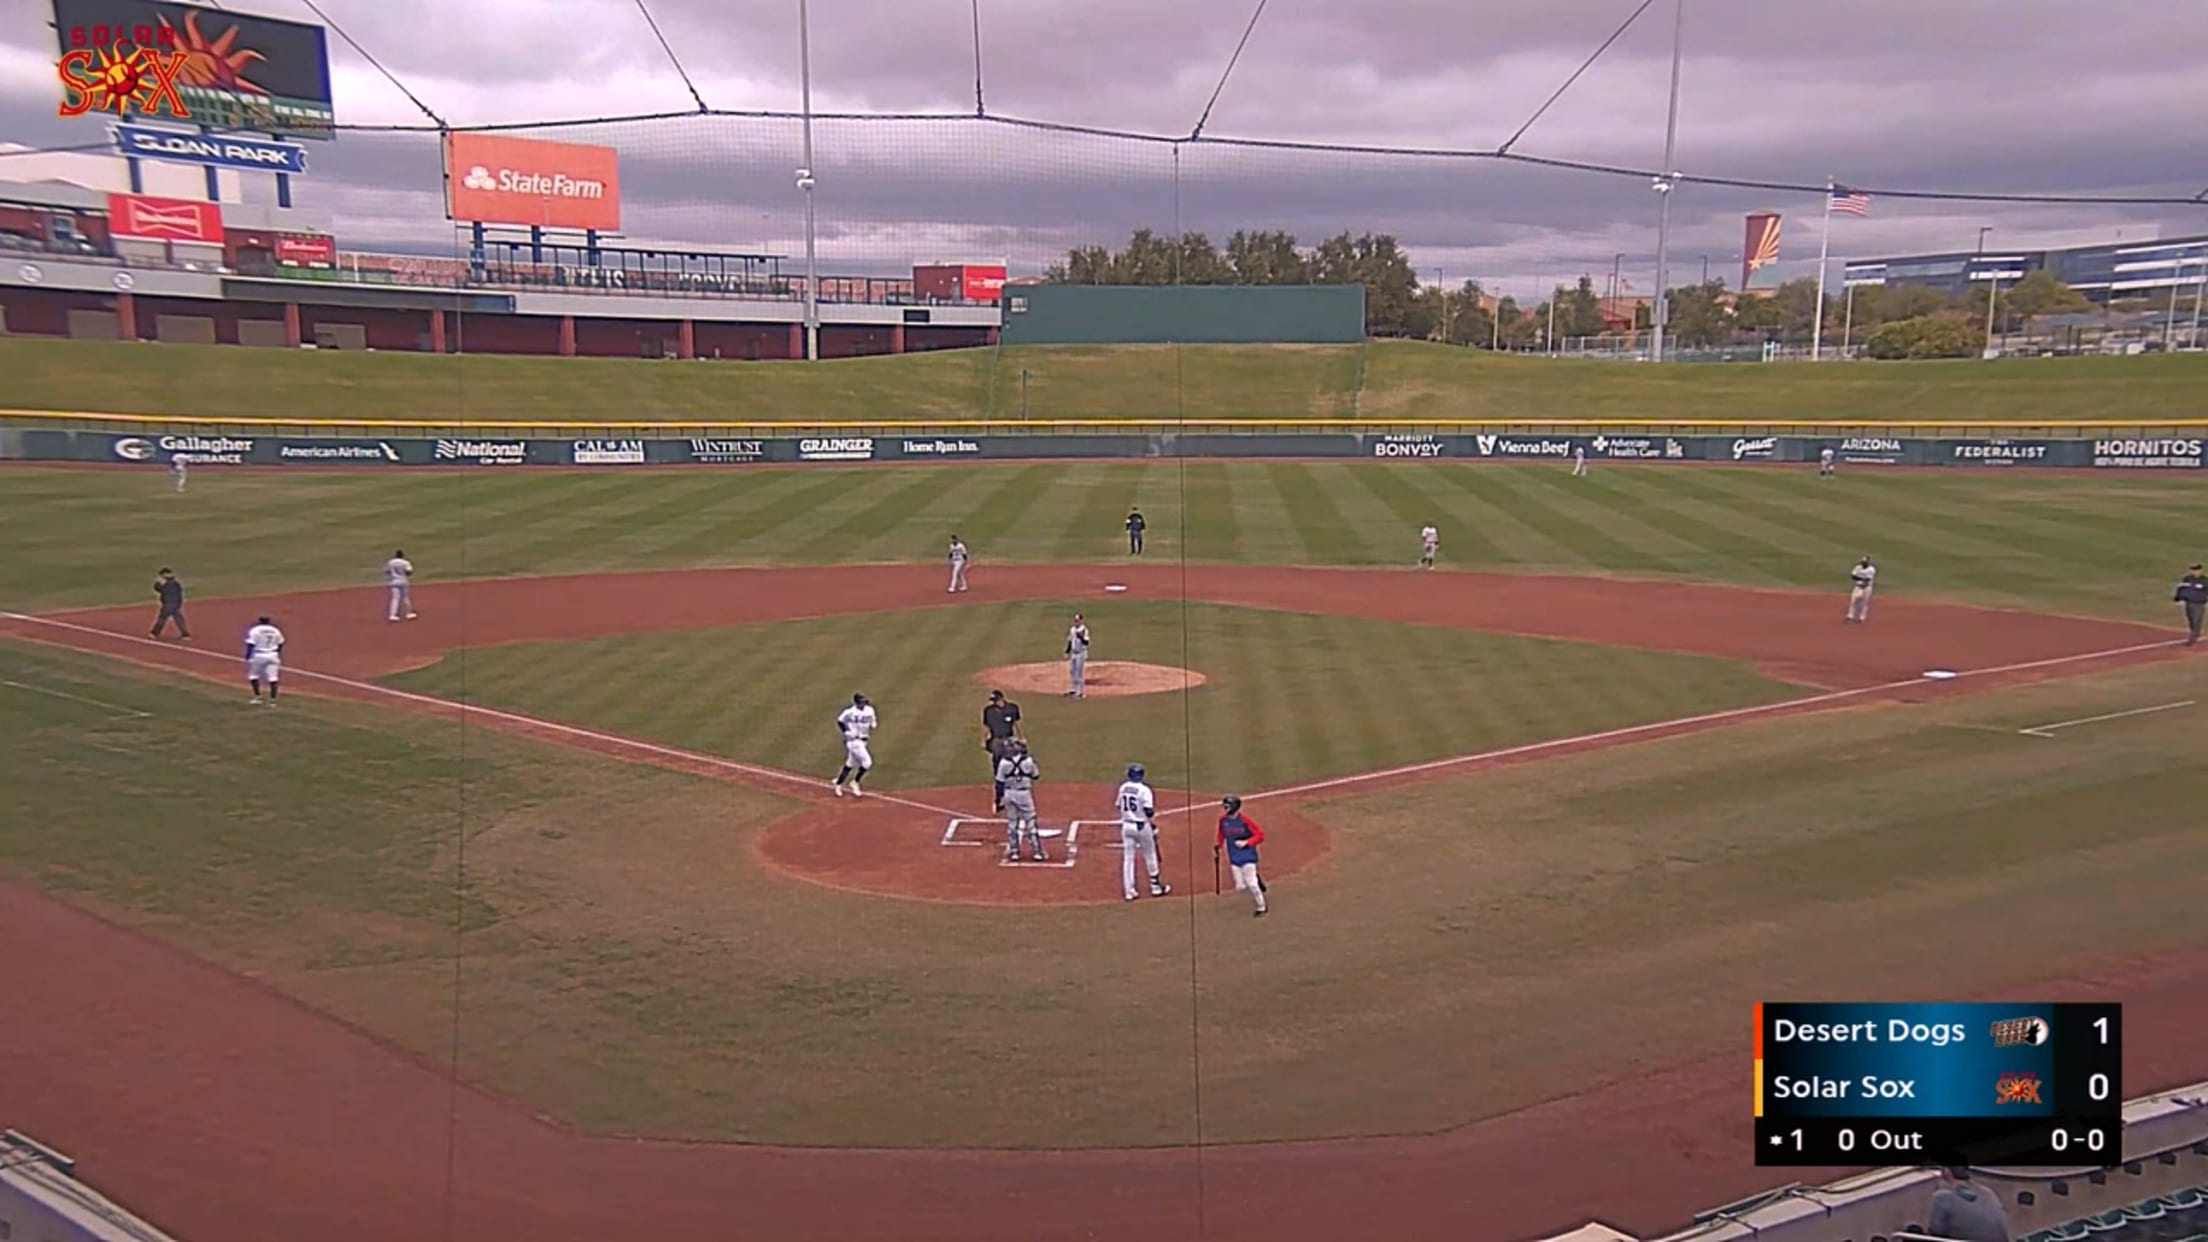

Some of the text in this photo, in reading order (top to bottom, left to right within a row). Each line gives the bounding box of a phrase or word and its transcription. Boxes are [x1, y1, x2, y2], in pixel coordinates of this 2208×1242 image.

[132, 133, 289, 165] SLOAN PARK
[160, 436, 253, 453] Gallagher
[457, 442, 525, 457] National
[574, 440, 644, 452] CAL AM
[691, 438, 763, 452] WINTRUST
[800, 439, 875, 452] GRAINGER
[903, 441, 934, 453] Home
[935, 440, 957, 454] Run
[1375, 442, 1444, 456] BONVOY
[1499, 440, 1571, 457] Vienna Beef
[1841, 439, 1901, 450] ARIZONA
[2095, 440, 2202, 455] HORNITOS
[281, 446, 381, 458] American Airlines
[1955, 446, 2046, 458] FEDERALIST
[1122, 795, 1138, 812] 16
